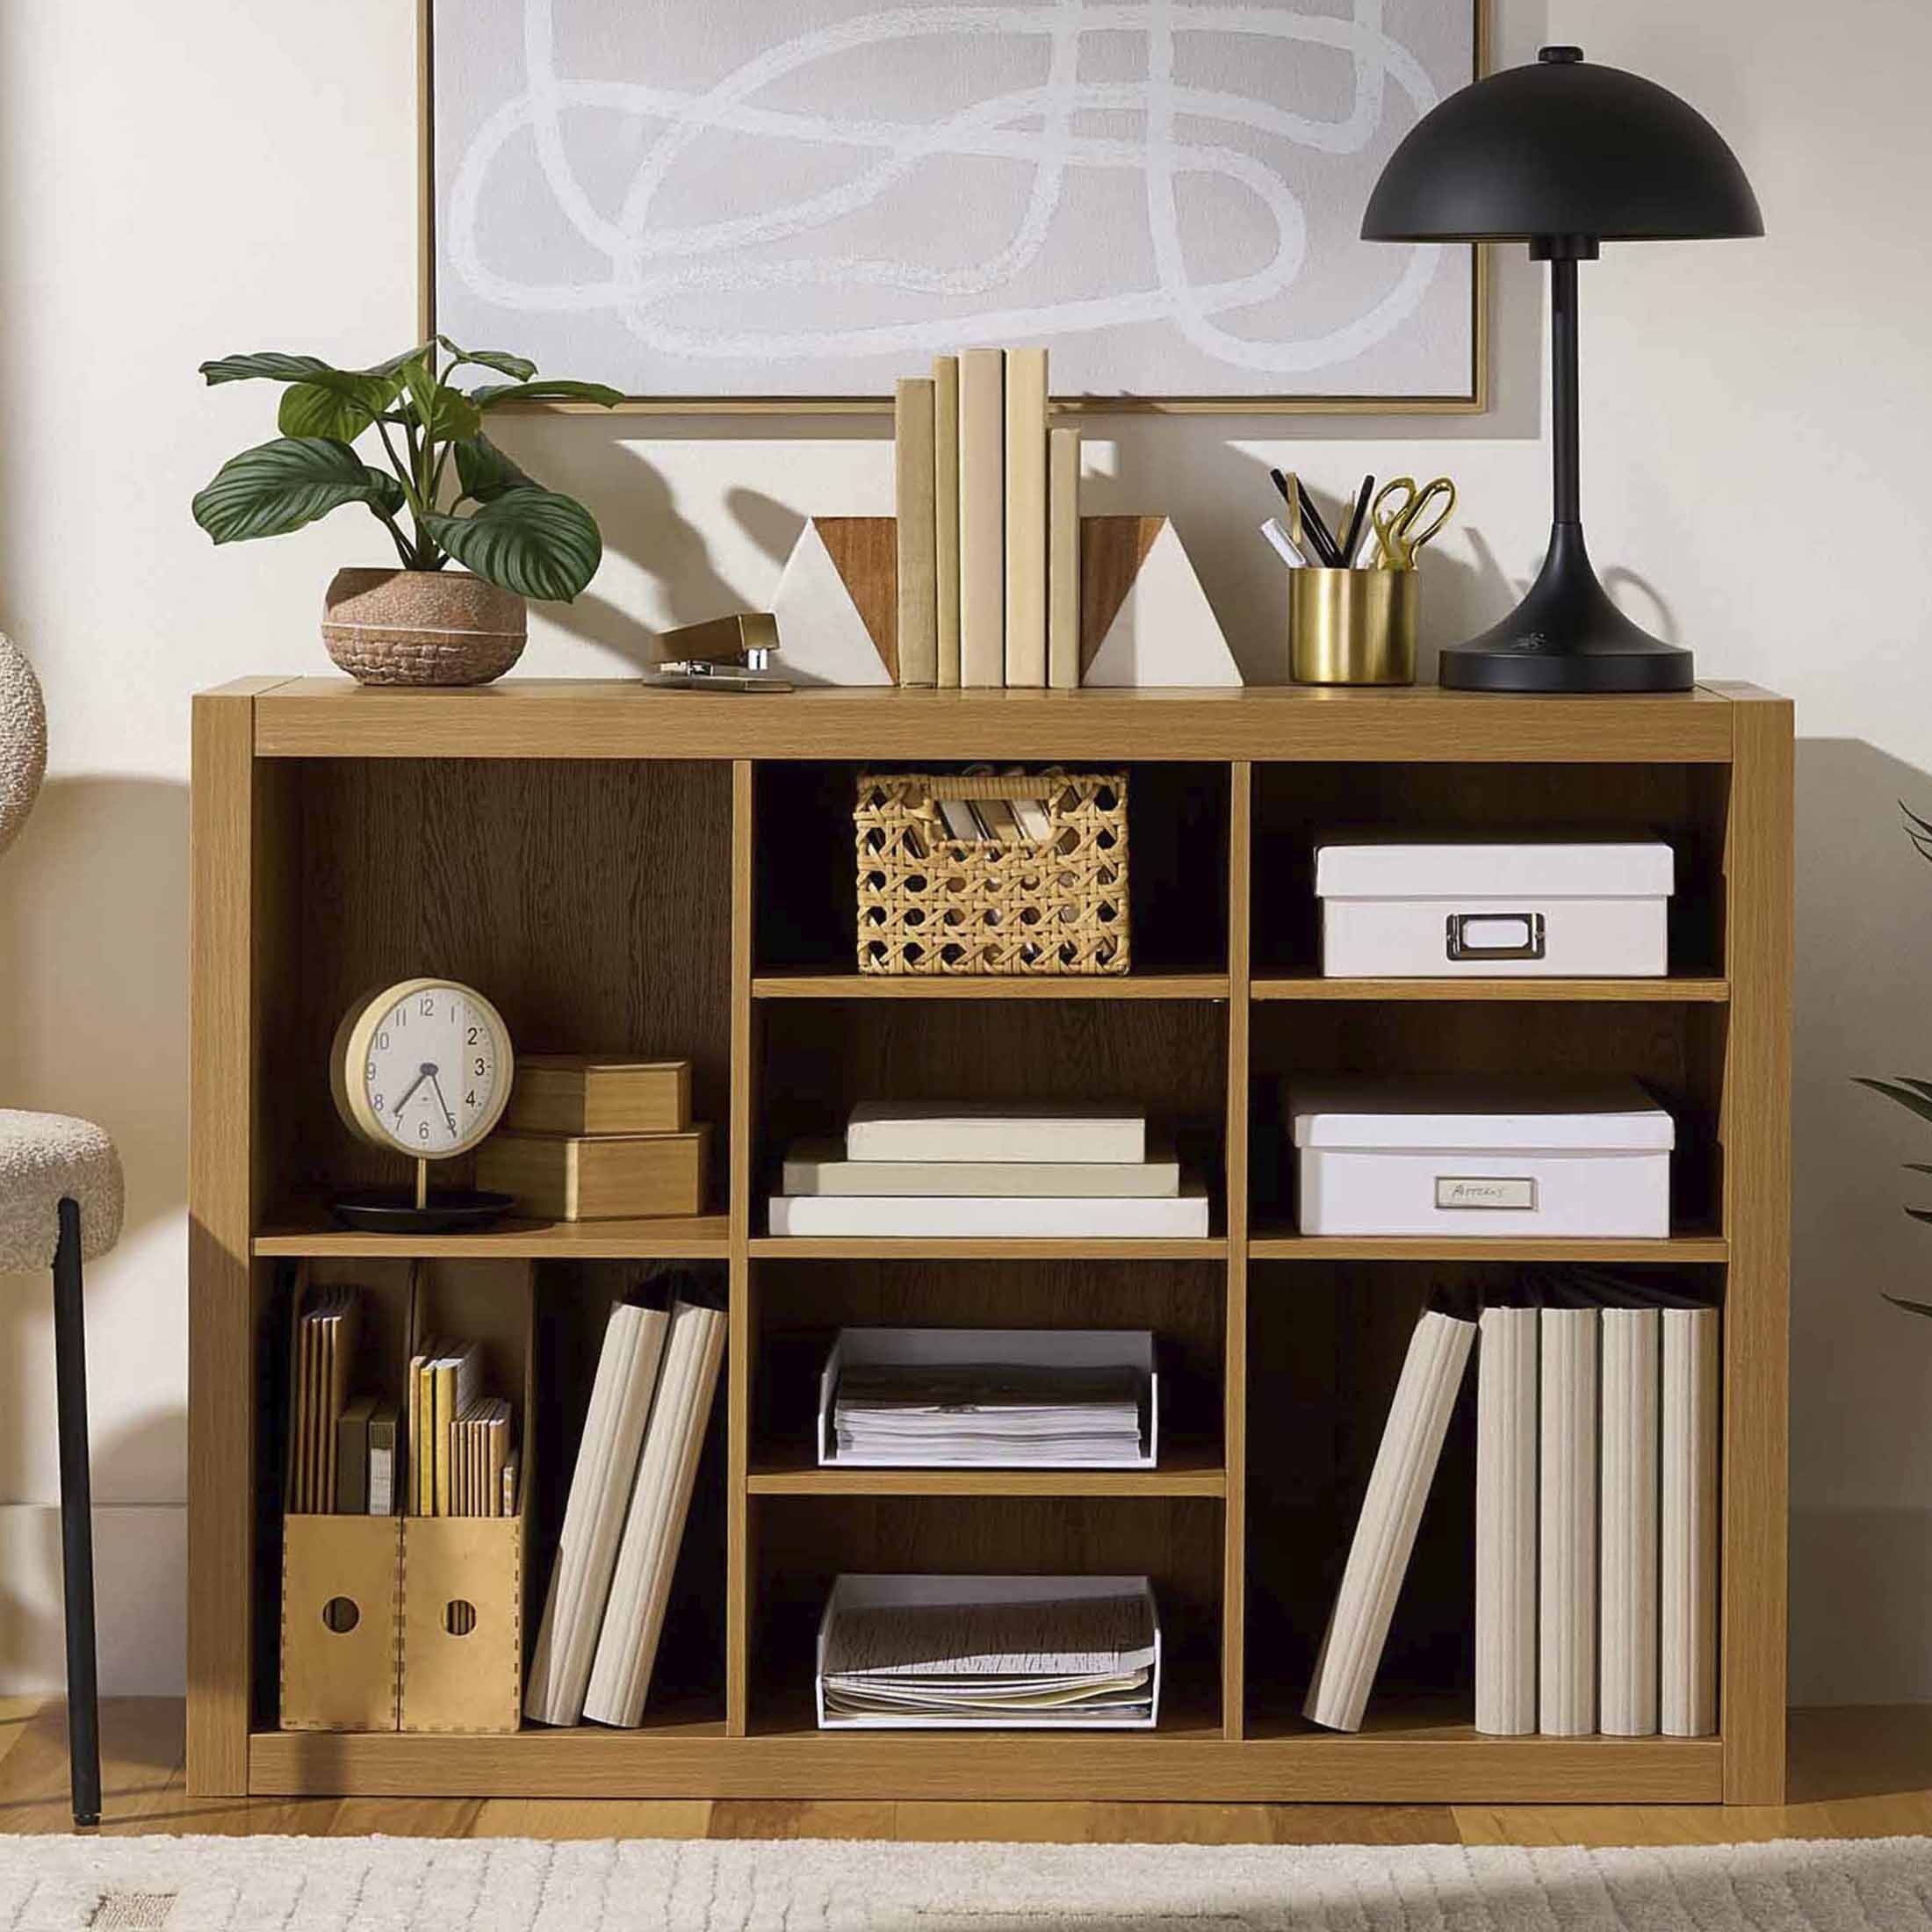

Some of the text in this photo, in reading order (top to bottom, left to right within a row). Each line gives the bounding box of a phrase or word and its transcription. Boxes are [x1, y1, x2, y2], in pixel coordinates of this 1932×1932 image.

[420, 998, 434, 1016] 12
[396, 1008, 407, 1027] 11
[374, 1033, 389, 1050] 10
[467, 1027, 478, 1046] 2
[365, 1063, 376, 1080] 9
[474, 1057, 485, 1076] 3
[374, 1094, 384, 1111] 8
[465, 1090, 475, 1107] 4
[394, 1114, 403, 1131] 7
[419, 1121, 429, 1139] 6
